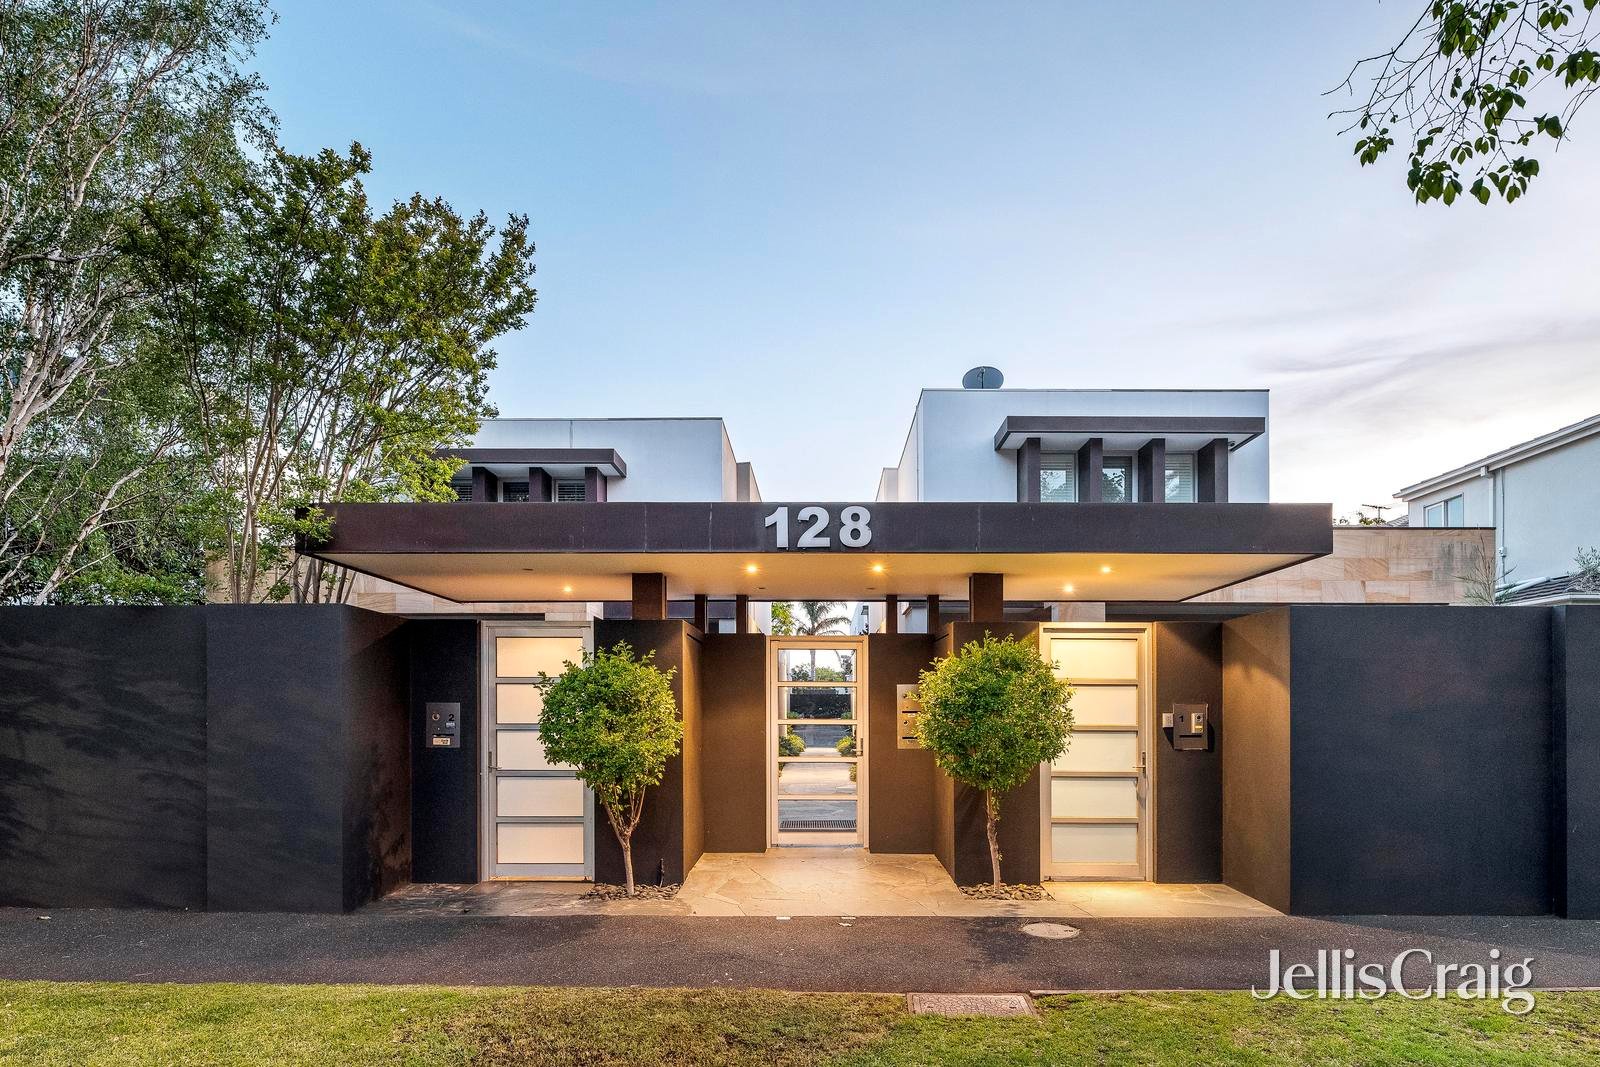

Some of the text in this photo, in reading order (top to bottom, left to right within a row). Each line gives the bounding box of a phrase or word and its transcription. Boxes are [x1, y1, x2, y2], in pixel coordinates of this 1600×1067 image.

[764, 505, 872, 548] 128
[448, 713, 455, 721] 2
[1179, 715, 1184, 723] 1
